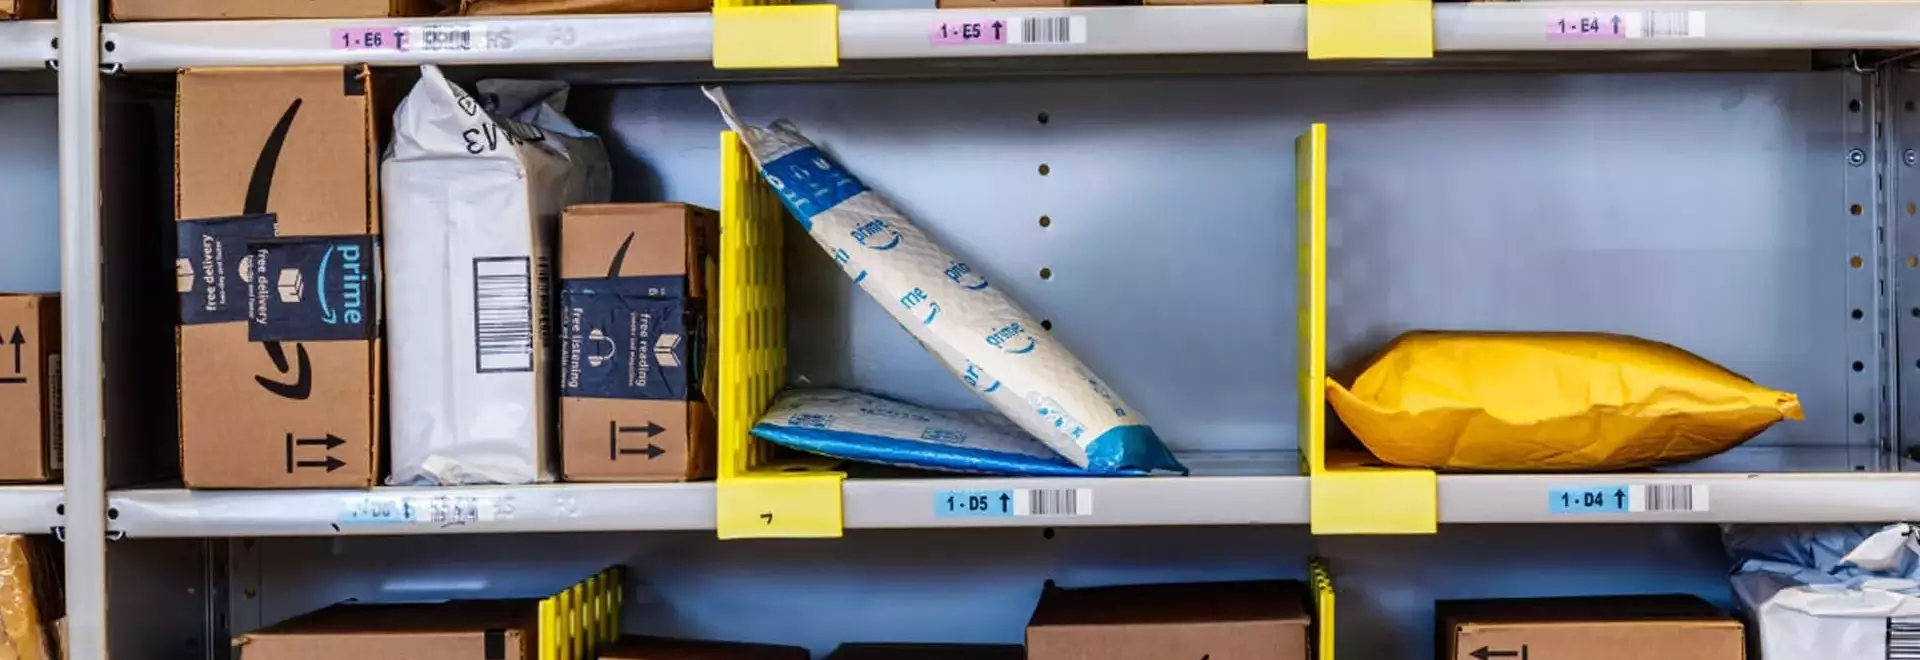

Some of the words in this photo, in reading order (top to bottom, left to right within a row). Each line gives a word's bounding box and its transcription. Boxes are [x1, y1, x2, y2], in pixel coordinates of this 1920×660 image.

[941, 23, 948, 38] 1
[962, 23, 981, 39] E5
[1558, 19, 1565, 33] 1
[1580, 18, 1600, 33] E4
[341, 32, 350, 47] 1
[364, 32, 382, 47] E6
[850, 219, 889, 246] prime
[202, 234, 217, 283] delivery
[257, 249, 269, 273] free
[336, 244, 367, 324] prime
[204, 285, 217, 311] free
[256, 276, 269, 325] delivery
[900, 287, 928, 309] me
[571, 307, 584, 332] free
[639, 312, 652, 338] free
[985, 322, 1025, 350] prime
[568, 334, 583, 388] listening
[635, 341, 650, 387] reading
[947, 496, 954, 511] 1
[968, 495, 988, 511] D5
[1561, 492, 1569, 507] 1
[1583, 492, 1604, 508] D4
